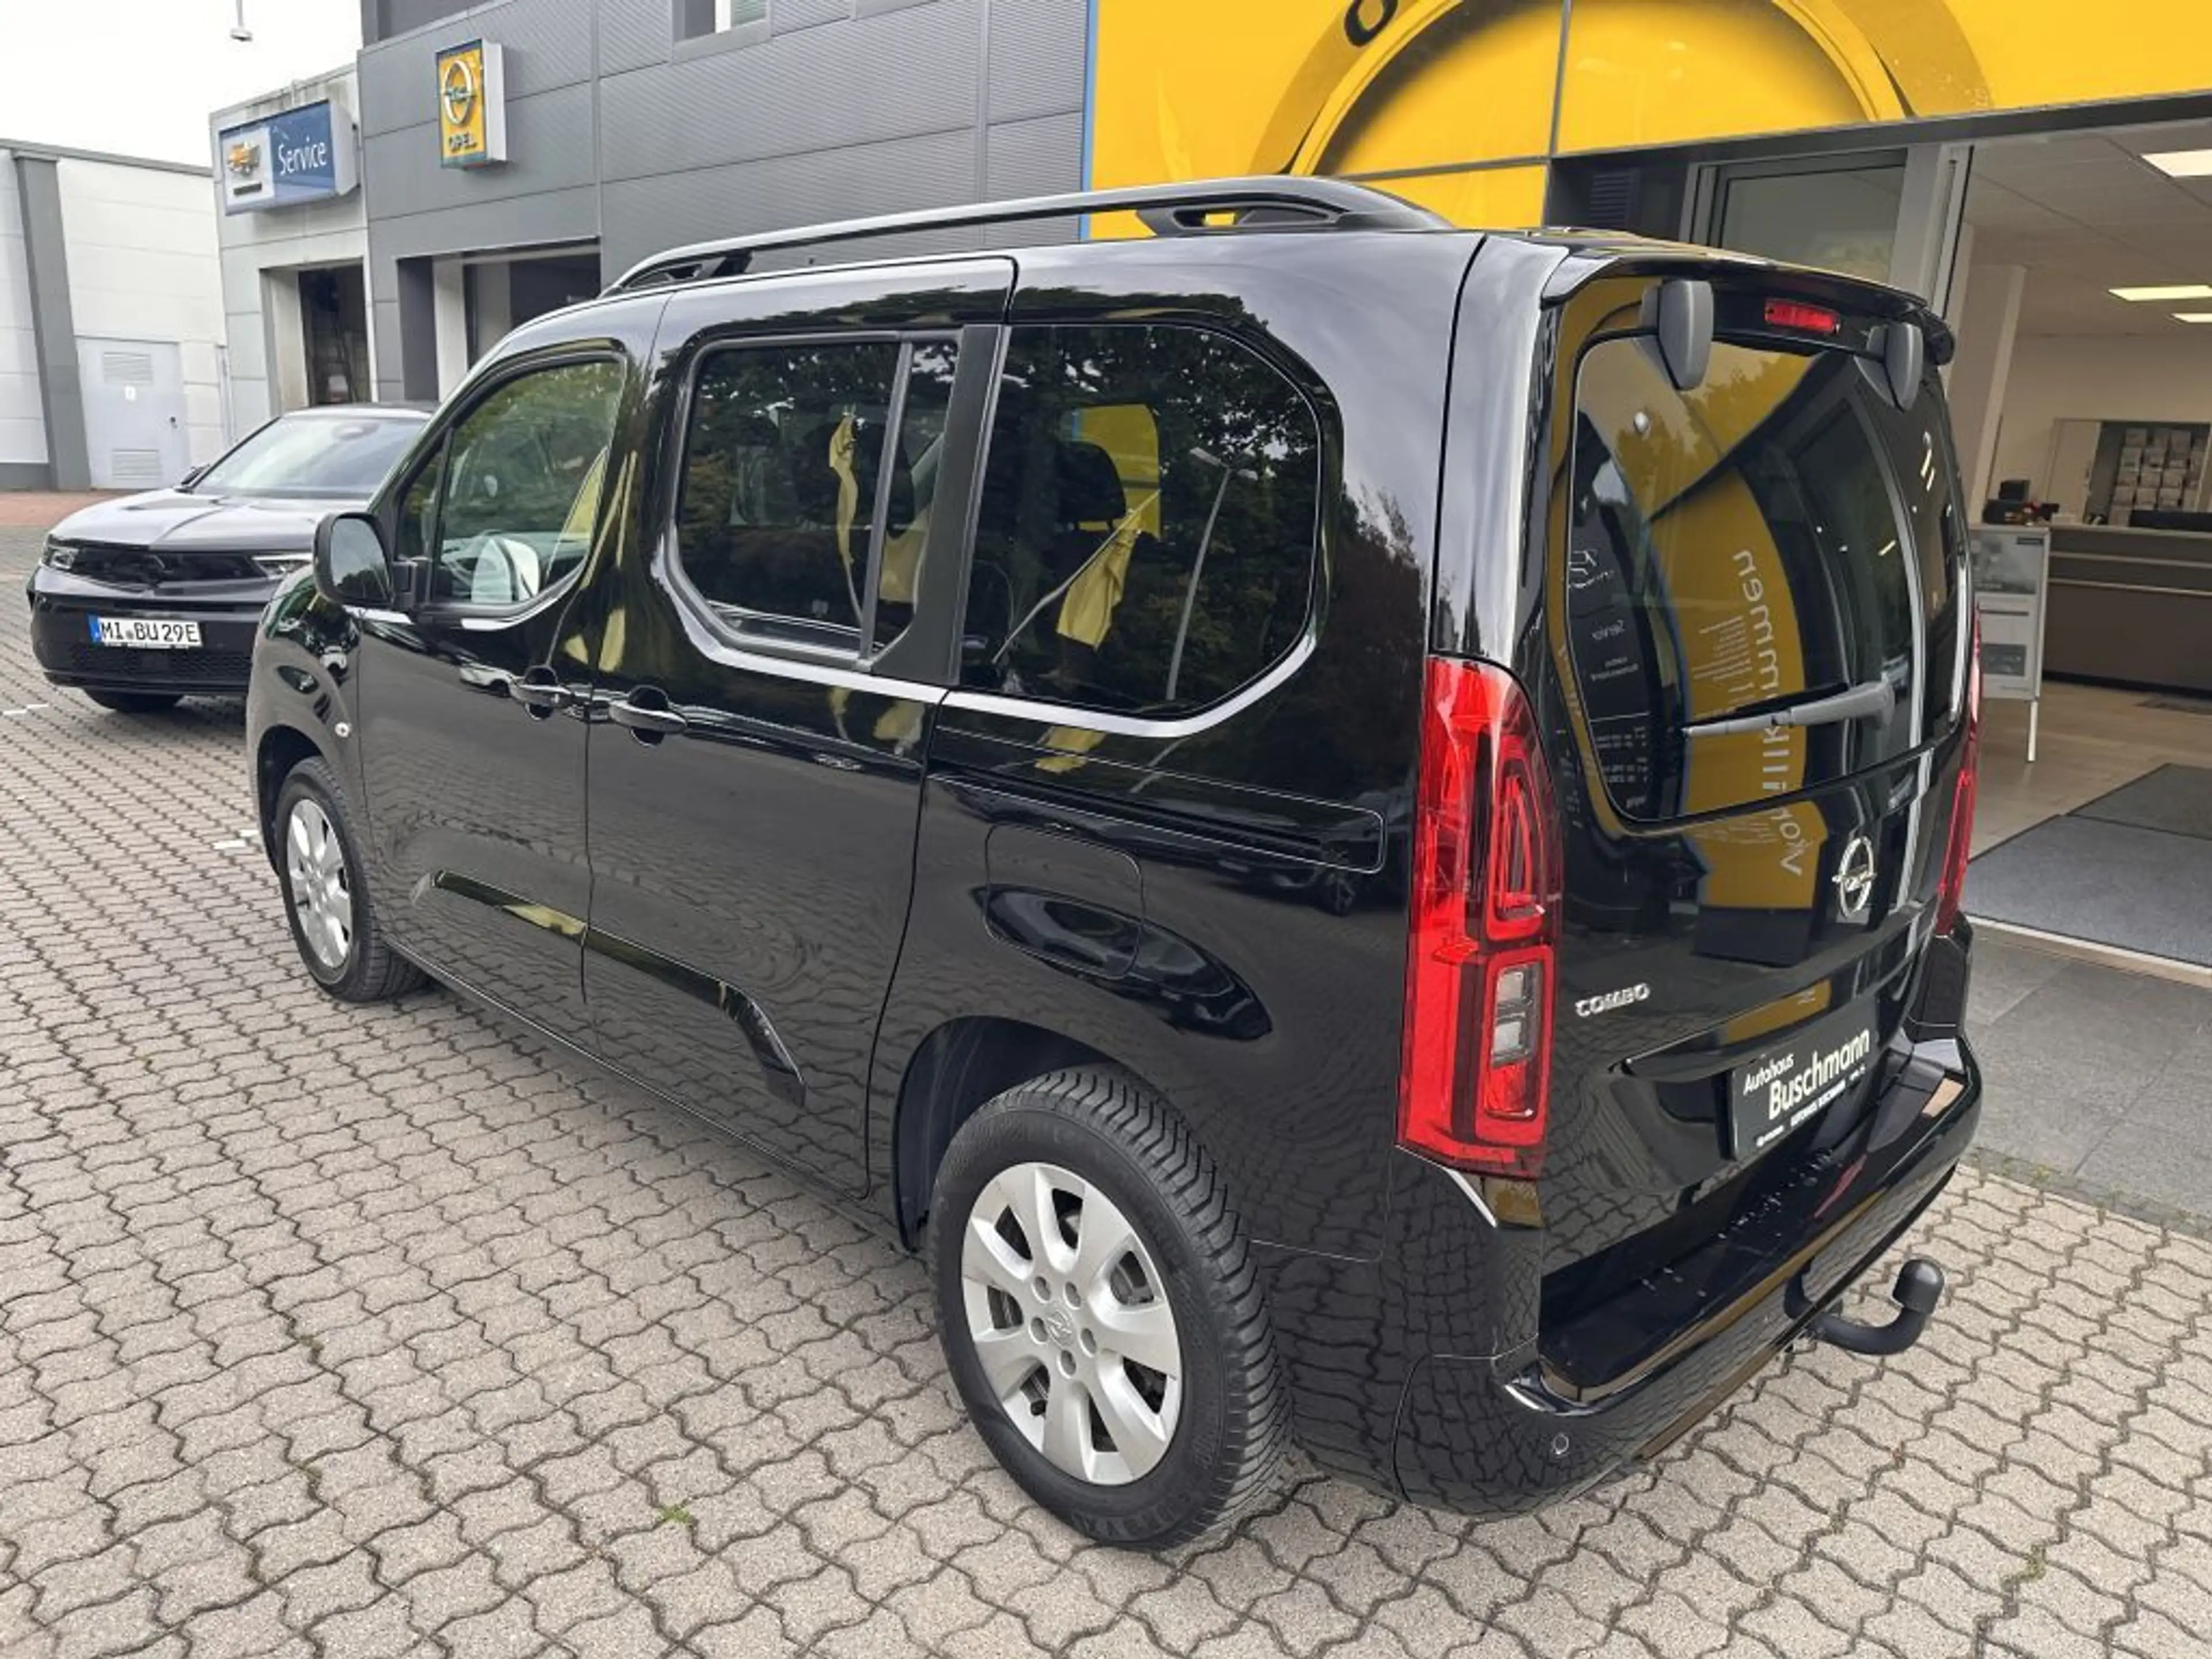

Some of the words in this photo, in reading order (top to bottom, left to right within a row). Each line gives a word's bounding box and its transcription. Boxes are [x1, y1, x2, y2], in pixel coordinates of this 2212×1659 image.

[278, 135, 327, 176] Service
[1575, 982, 1651, 1017] COMBO
[1743, 1053, 1794, 1096] Autohaus
[1768, 1028, 1870, 1120] Buschmann
